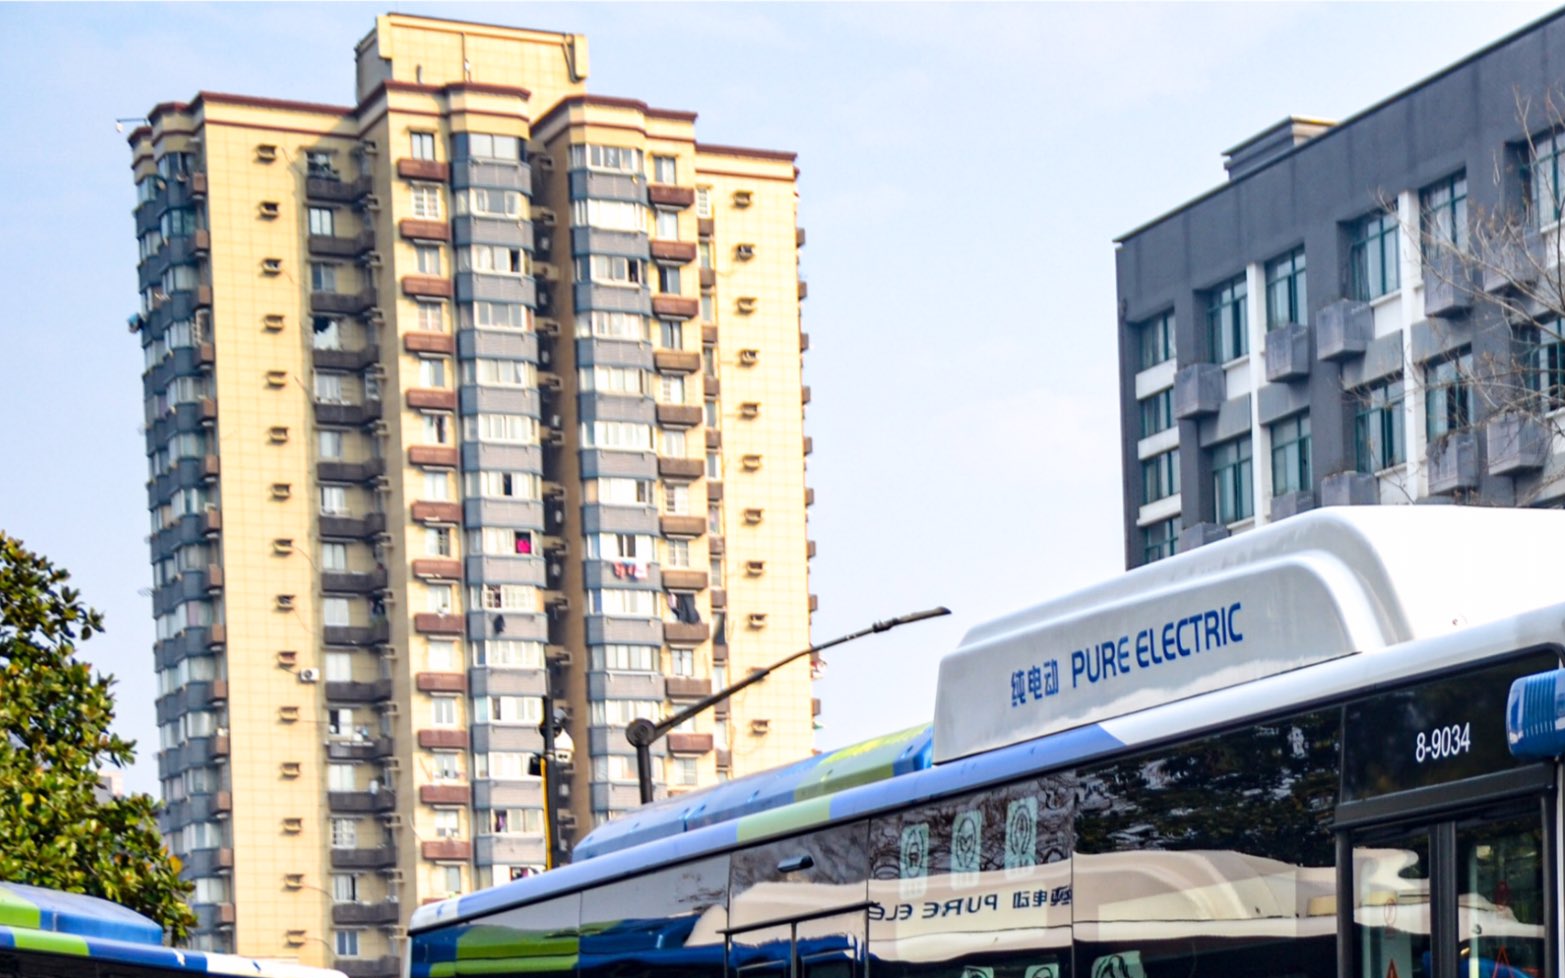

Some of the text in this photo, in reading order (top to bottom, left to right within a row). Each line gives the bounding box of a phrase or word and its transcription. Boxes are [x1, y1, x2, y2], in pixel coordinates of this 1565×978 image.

[1011, 602, 1243, 707] 纯电动 PURE ELECTRIC
[1415, 721, 1471, 763] 8-9034
